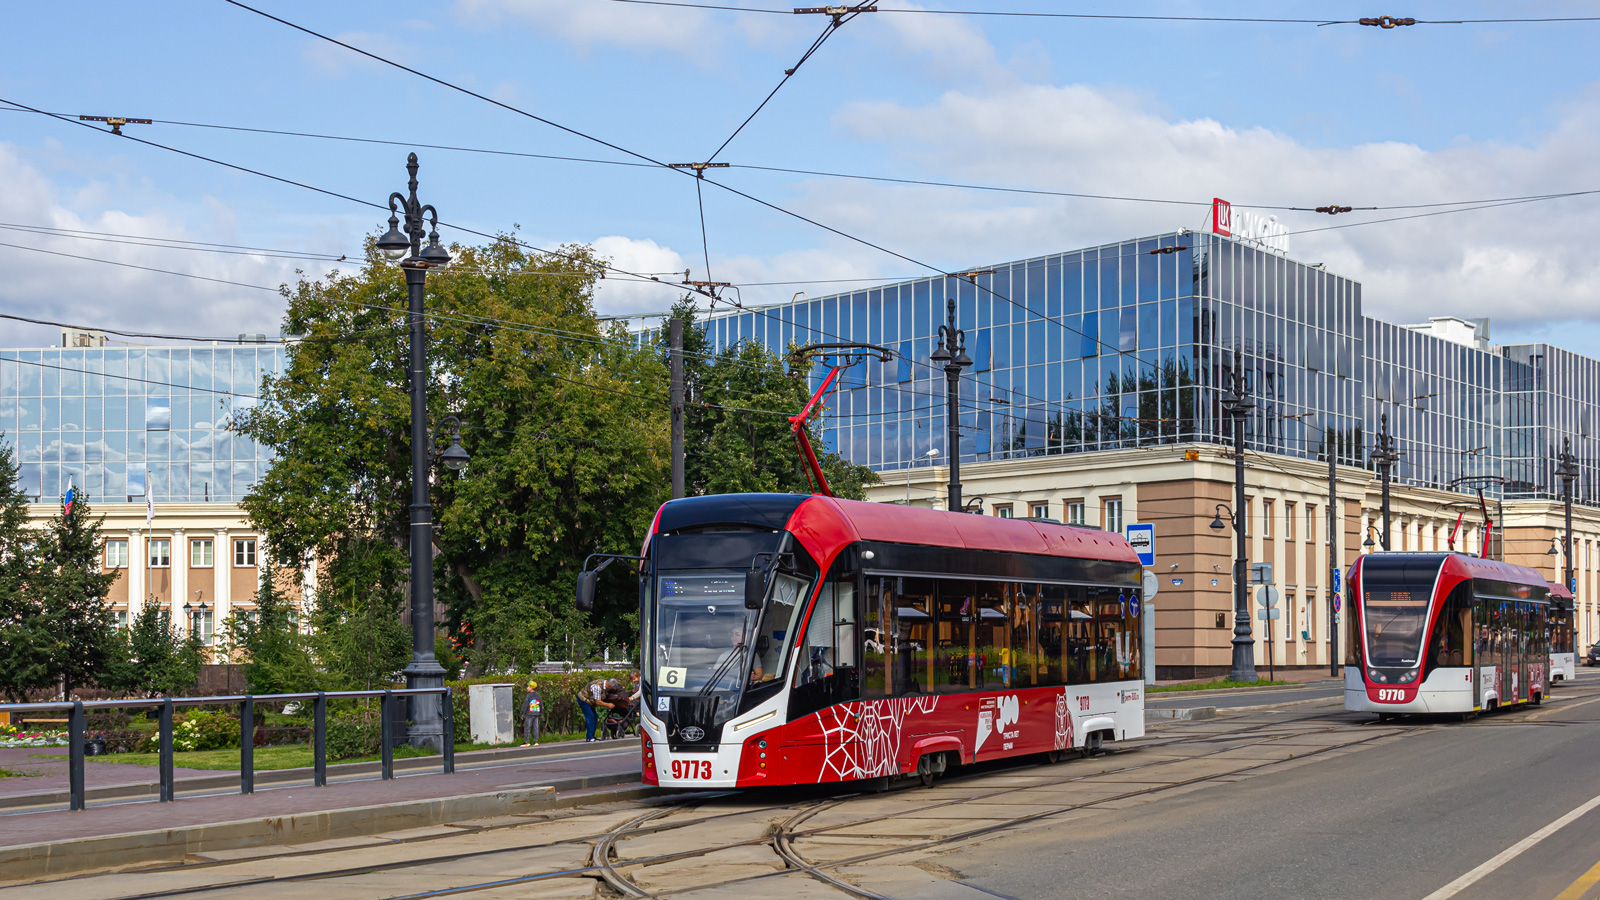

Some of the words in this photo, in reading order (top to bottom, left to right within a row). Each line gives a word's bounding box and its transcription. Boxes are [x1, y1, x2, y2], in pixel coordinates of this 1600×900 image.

[666, 670, 678, 684] 6
[1379, 689, 1405, 701] 9770
[671, 760, 712, 780] 9773
